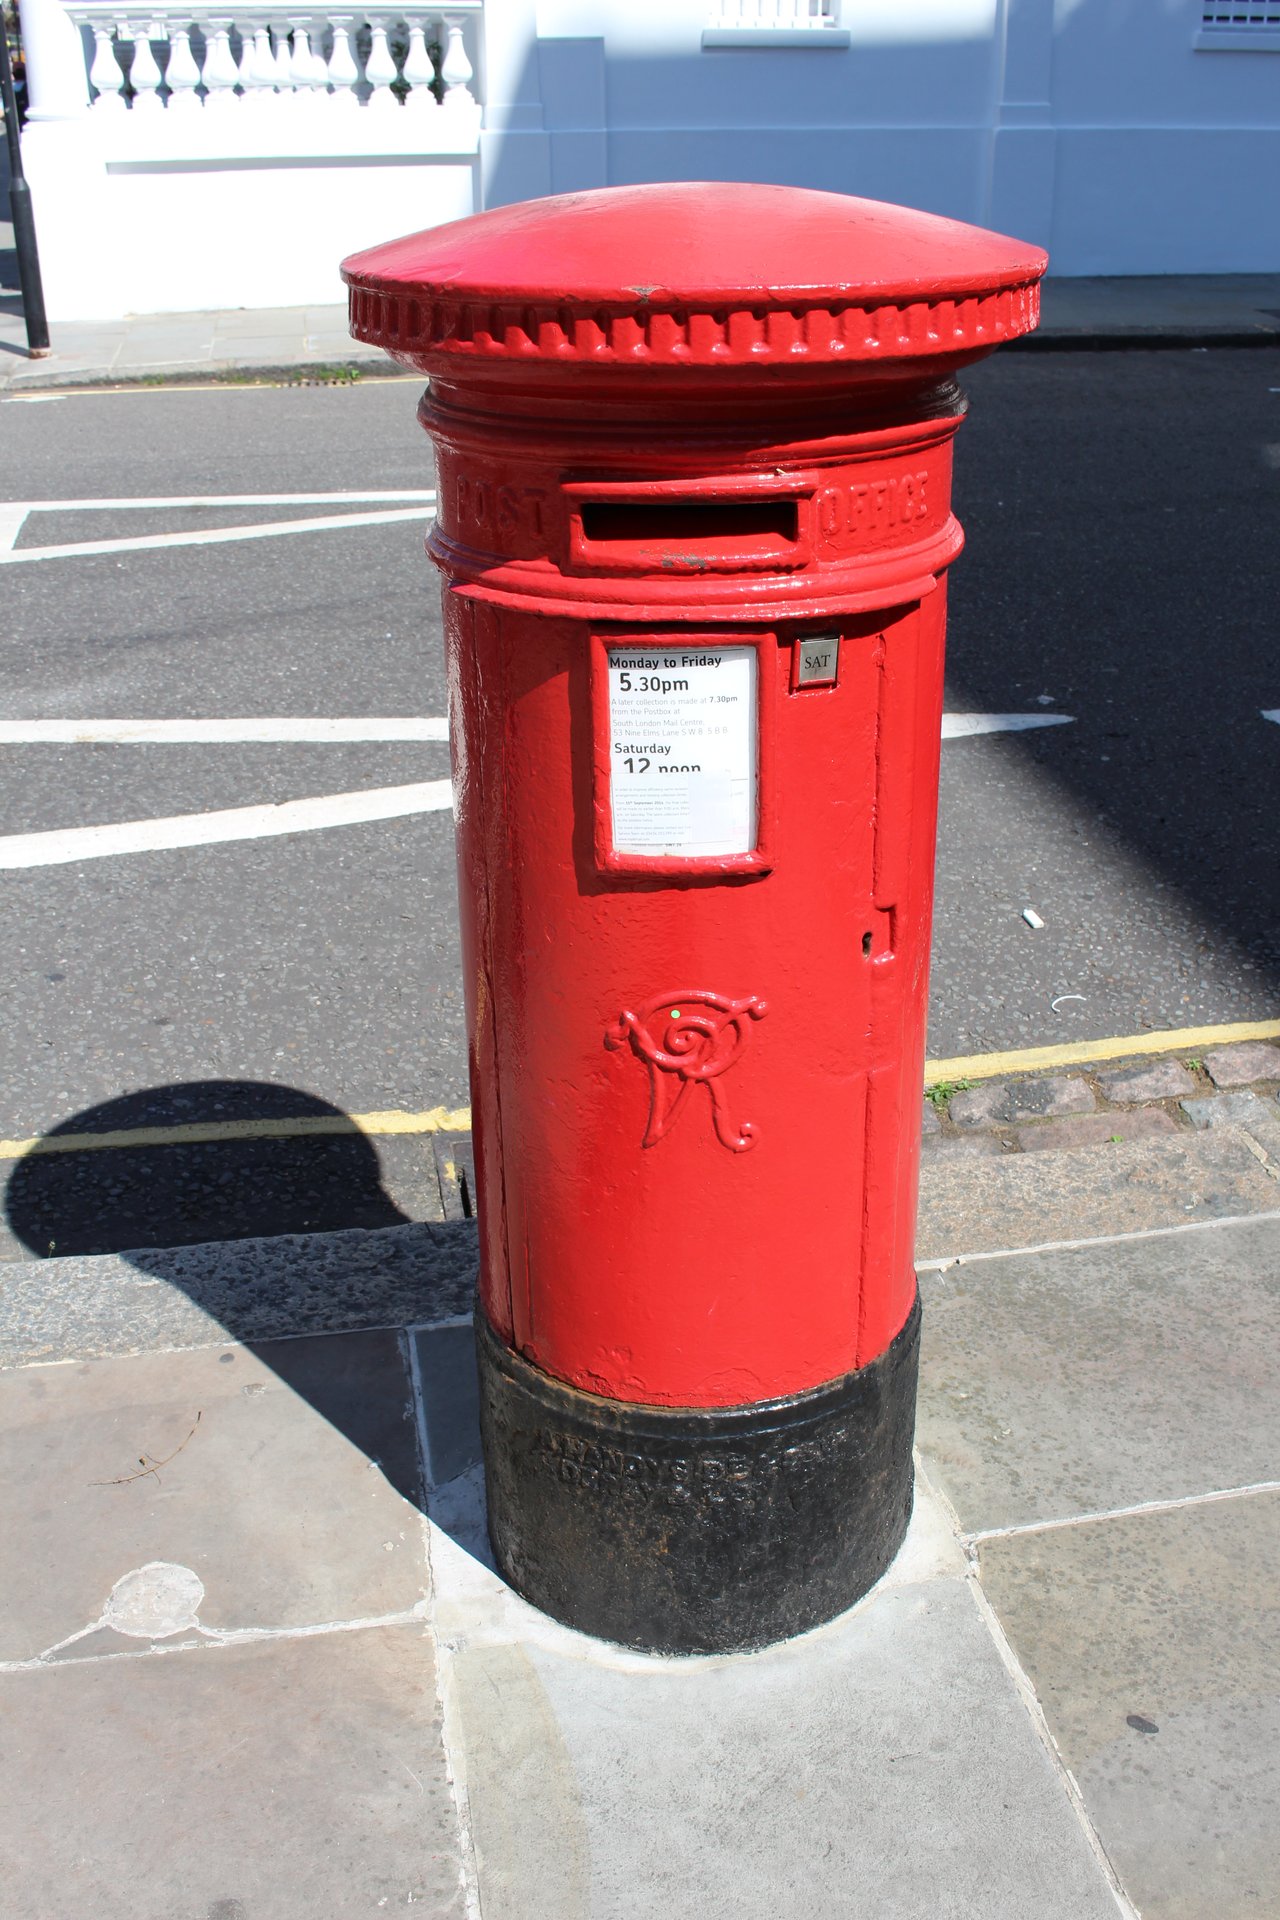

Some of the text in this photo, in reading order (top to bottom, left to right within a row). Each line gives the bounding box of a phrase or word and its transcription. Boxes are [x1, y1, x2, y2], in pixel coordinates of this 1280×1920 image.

[610, 656, 722, 670] Monday to Friday
[804, 654, 831, 669] SAT
[619, 672, 689, 694] 5.30pm
[709, 695, 738, 704] 7.30pm
[614, 743, 671, 756] Saturday
[623, 757, 651, 774] 12
